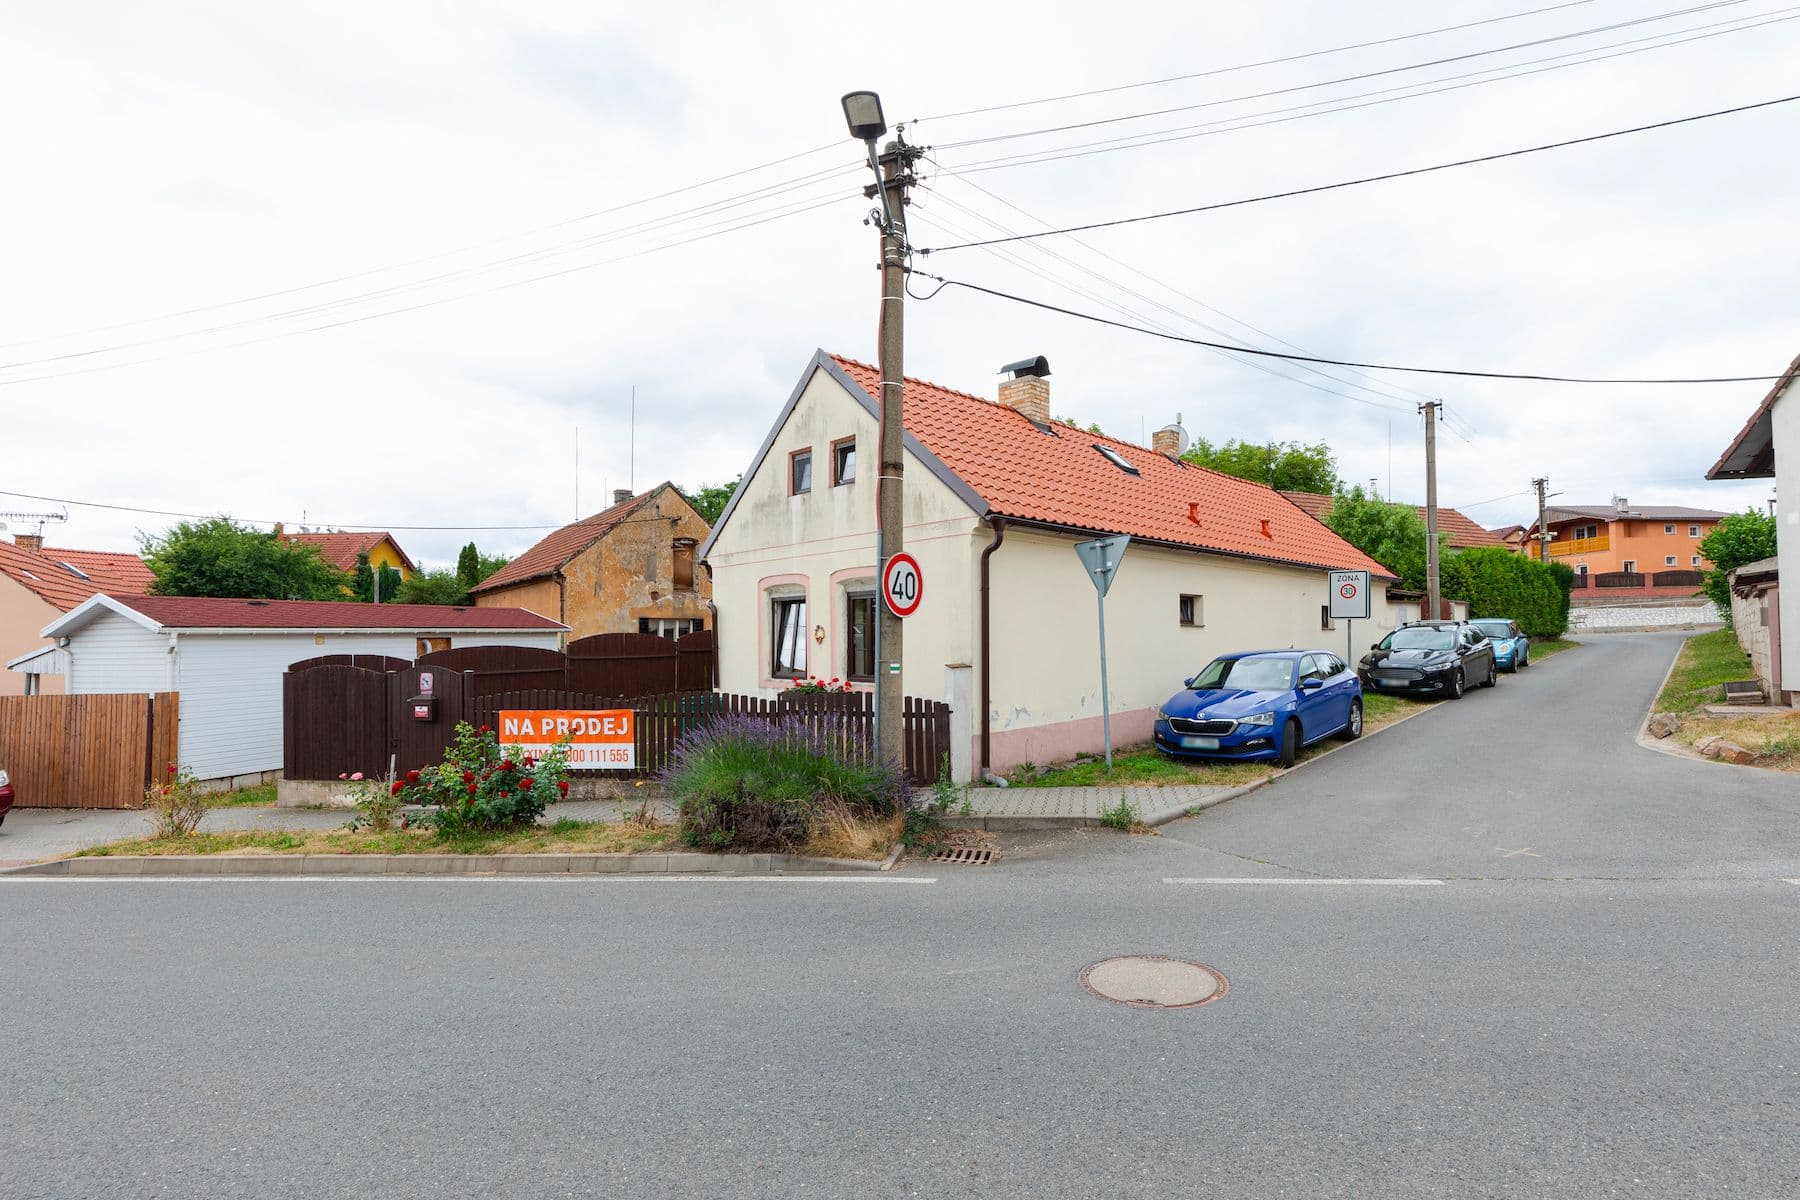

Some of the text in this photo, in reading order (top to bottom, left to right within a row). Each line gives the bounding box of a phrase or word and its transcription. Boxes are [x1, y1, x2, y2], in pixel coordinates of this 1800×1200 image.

[892, 570, 915, 600] 40
[1343, 587, 1353, 595] 30
[505, 717, 628, 736] NA PRODEJ
[589, 749, 606, 762] 111
[610, 749, 629, 762] 555
